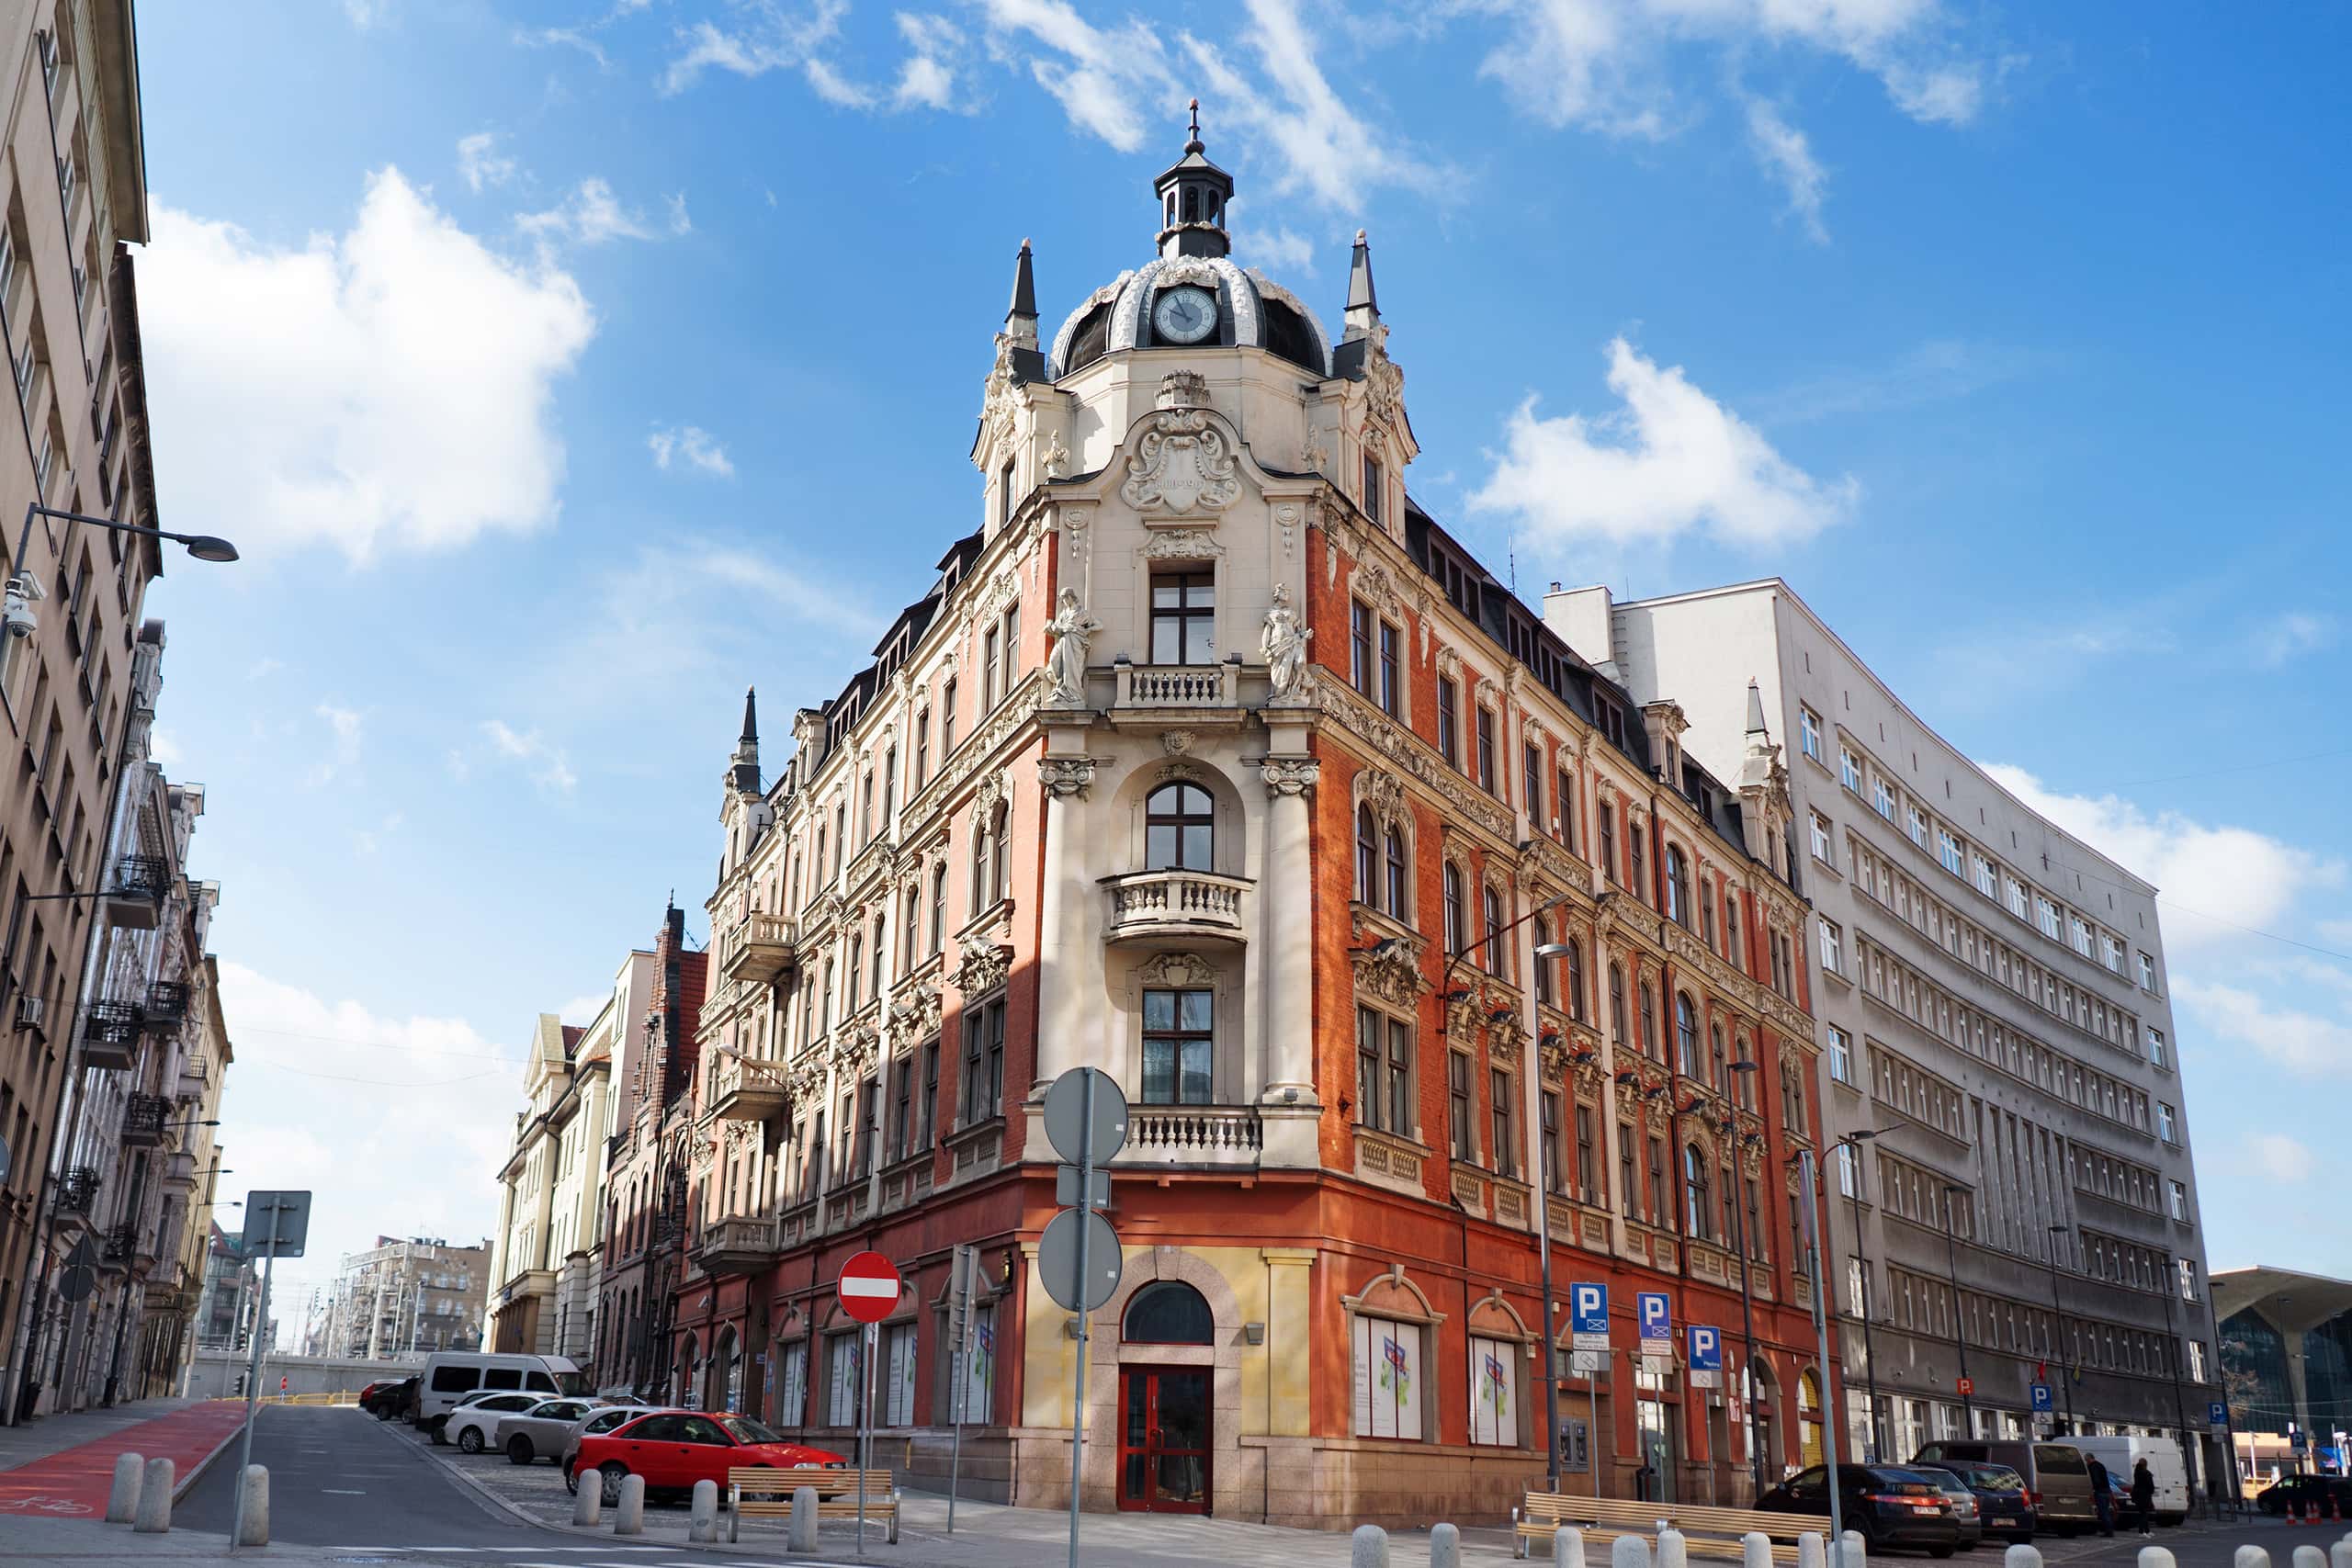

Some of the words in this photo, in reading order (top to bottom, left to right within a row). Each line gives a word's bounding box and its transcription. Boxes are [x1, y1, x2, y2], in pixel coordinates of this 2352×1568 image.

[1182, 294, 1191, 302] 12
[1578, 1287, 1600, 1318] P
[1645, 1296, 1664, 1325] P
[1694, 1329, 1714, 1357] P
[2034, 1387, 2047, 1404] P
[2211, 1404, 2222, 1417] P
